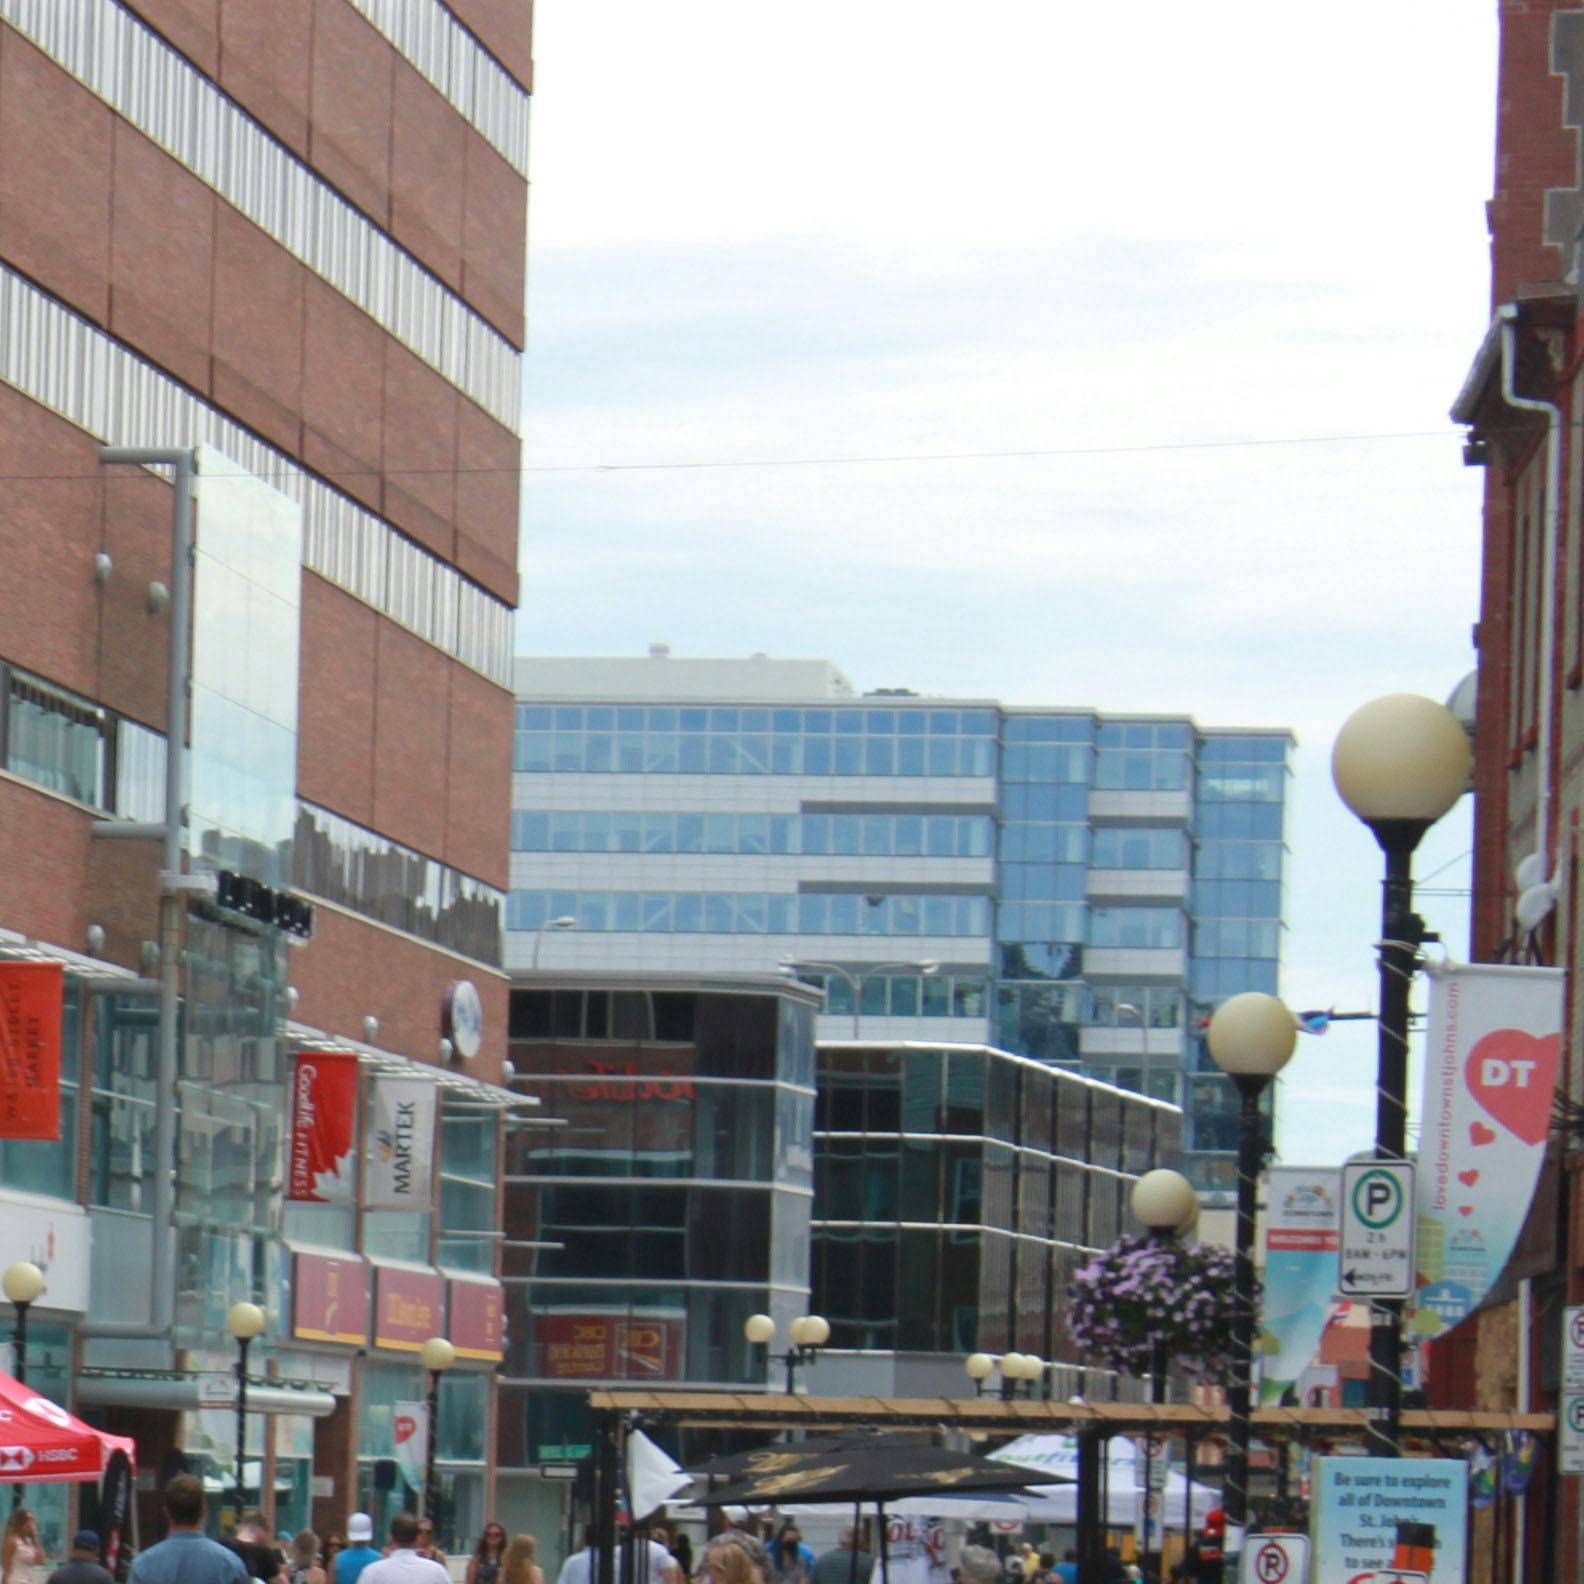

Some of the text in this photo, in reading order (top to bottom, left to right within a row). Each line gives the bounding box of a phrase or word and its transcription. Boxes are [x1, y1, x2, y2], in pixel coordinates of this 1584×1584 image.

[25, 1015, 41, 1088] MARKET
[1481, 1058, 1536, 1088] DT
[1432, 981, 1461, 1211] lovedowntownstjohns.com
[392, 1101, 416, 1195] MARTEK
[293, 1131, 309, 1197] FITNESS
[37, 1446, 79, 1462] HSBC
[1334, 1471, 1451, 1490] Be sure to explore
[1339, 1492, 1446, 1508] all of Downtown
[1344, 1557, 1360, 1569] to
[1362, 1558, 1383, 1569] see
